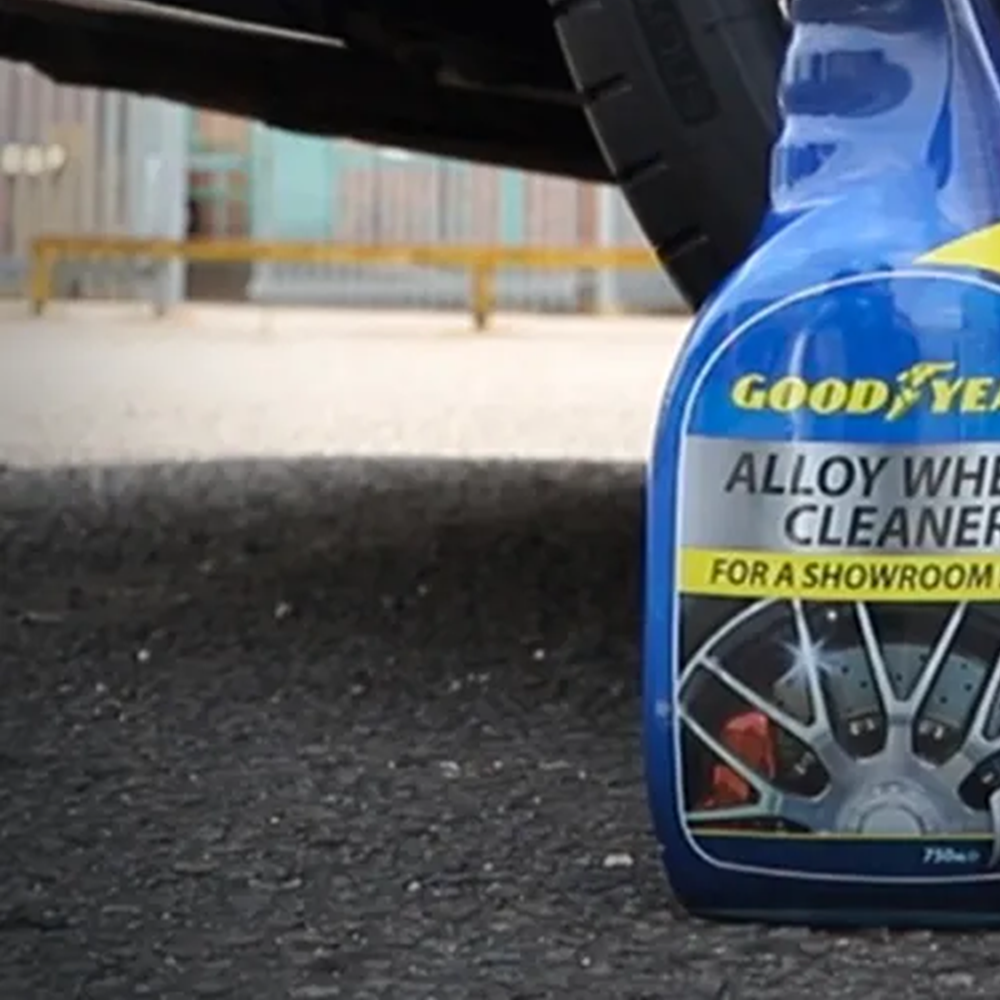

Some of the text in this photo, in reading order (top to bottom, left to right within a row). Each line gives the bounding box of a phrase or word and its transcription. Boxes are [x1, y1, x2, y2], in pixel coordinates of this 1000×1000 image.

[725, 452, 890, 496] ALLOY
[710, 558, 770, 586] FOR
[773, 561, 795, 587] A
[801, 561, 994, 591] SHOWROOM
